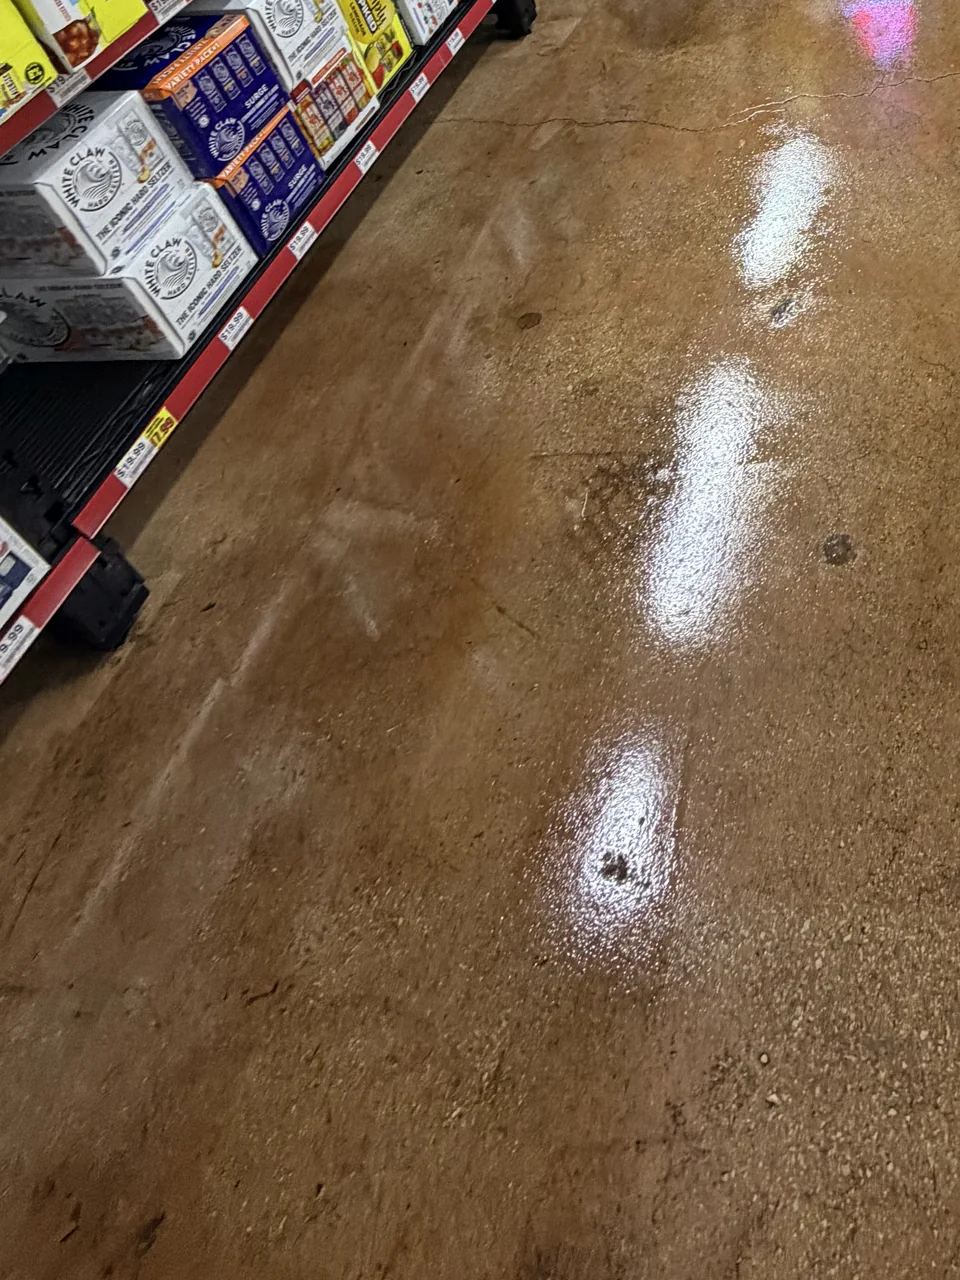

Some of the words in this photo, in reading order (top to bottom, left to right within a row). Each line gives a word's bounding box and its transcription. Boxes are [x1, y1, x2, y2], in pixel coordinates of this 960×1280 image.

[243, 83, 269, 109] SURGE
[69, 146, 106, 166] CLAW
[60, 163, 80, 208] WHITE
[288, 163, 307, 189] SURGE
[86, 195, 109, 209] HARD
[96, 227, 112, 241] THE
[110, 201, 133, 232] ICONIC
[130, 183, 150, 207] HARD
[147, 161, 173, 190] SELTZER
[150, 236, 182, 257] CLAW
[289, 224, 311, 251] $19.99
[144, 252, 162, 298] WHITE
[175, 312, 190, 327] THE
[187, 287, 208, 315] ICONIC
[206, 269, 223, 292] HARD
[220, 245, 243, 274] SELTZER
[219, 311, 244, 340] $19.99
[117, 442, 146, 479] $19.99
